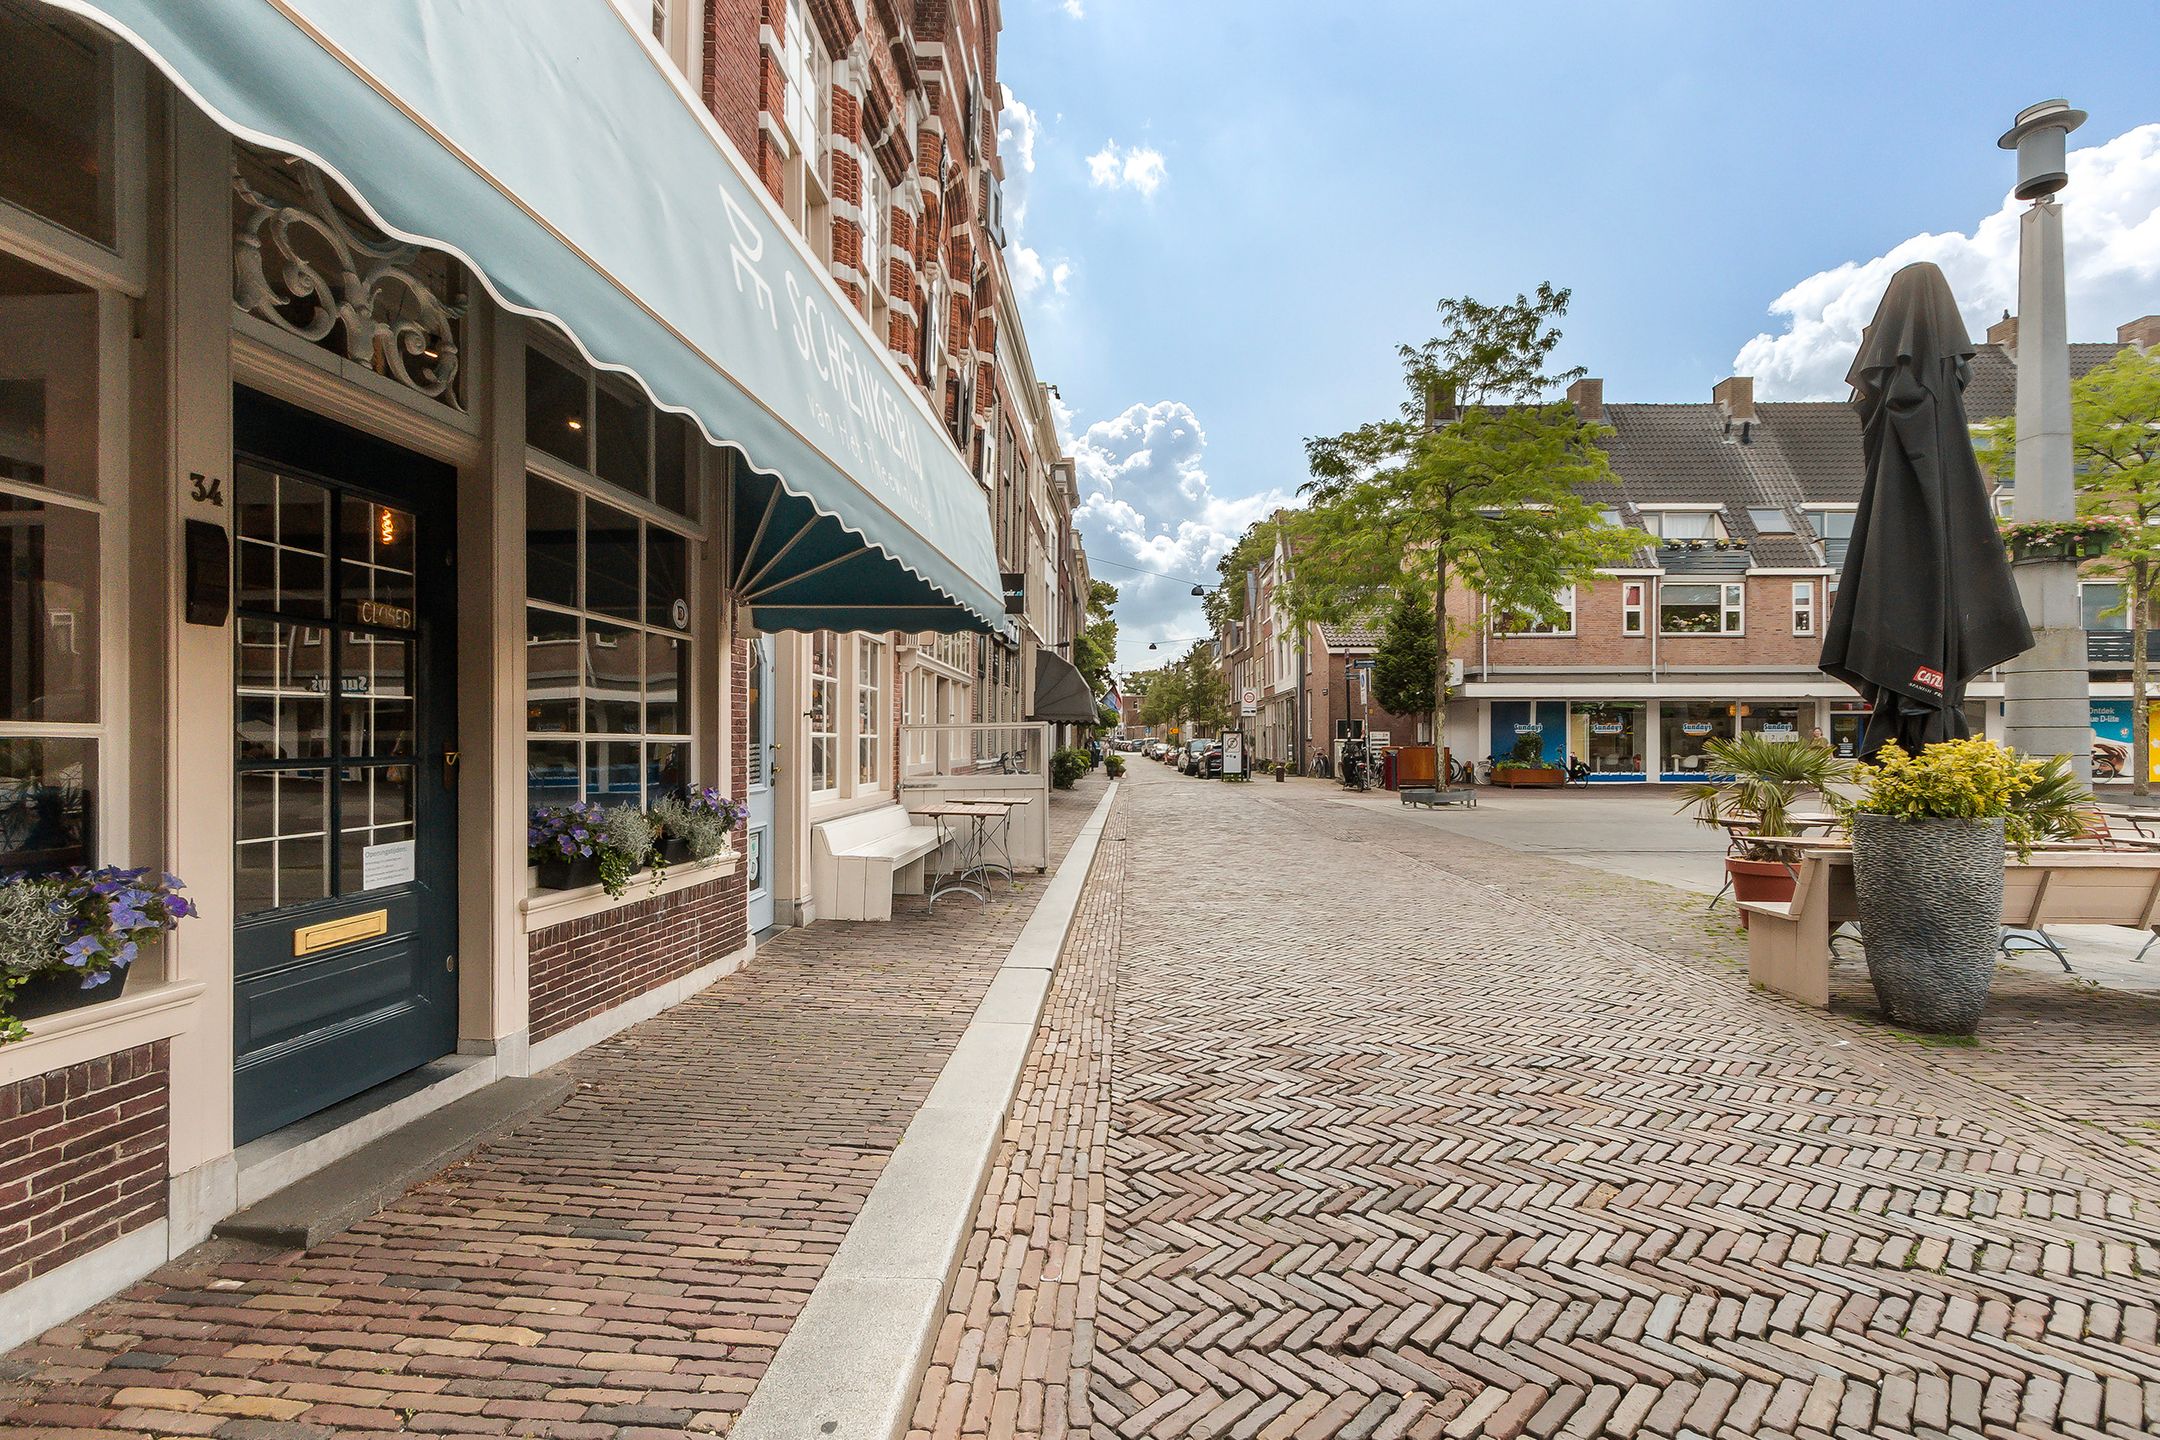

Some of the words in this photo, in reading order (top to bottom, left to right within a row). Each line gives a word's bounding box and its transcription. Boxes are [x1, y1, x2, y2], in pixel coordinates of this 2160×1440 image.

[785, 269, 923, 481] SCHENKERIJ
[190, 472, 224, 507] 34
[362, 601, 411, 629] CLOSED
